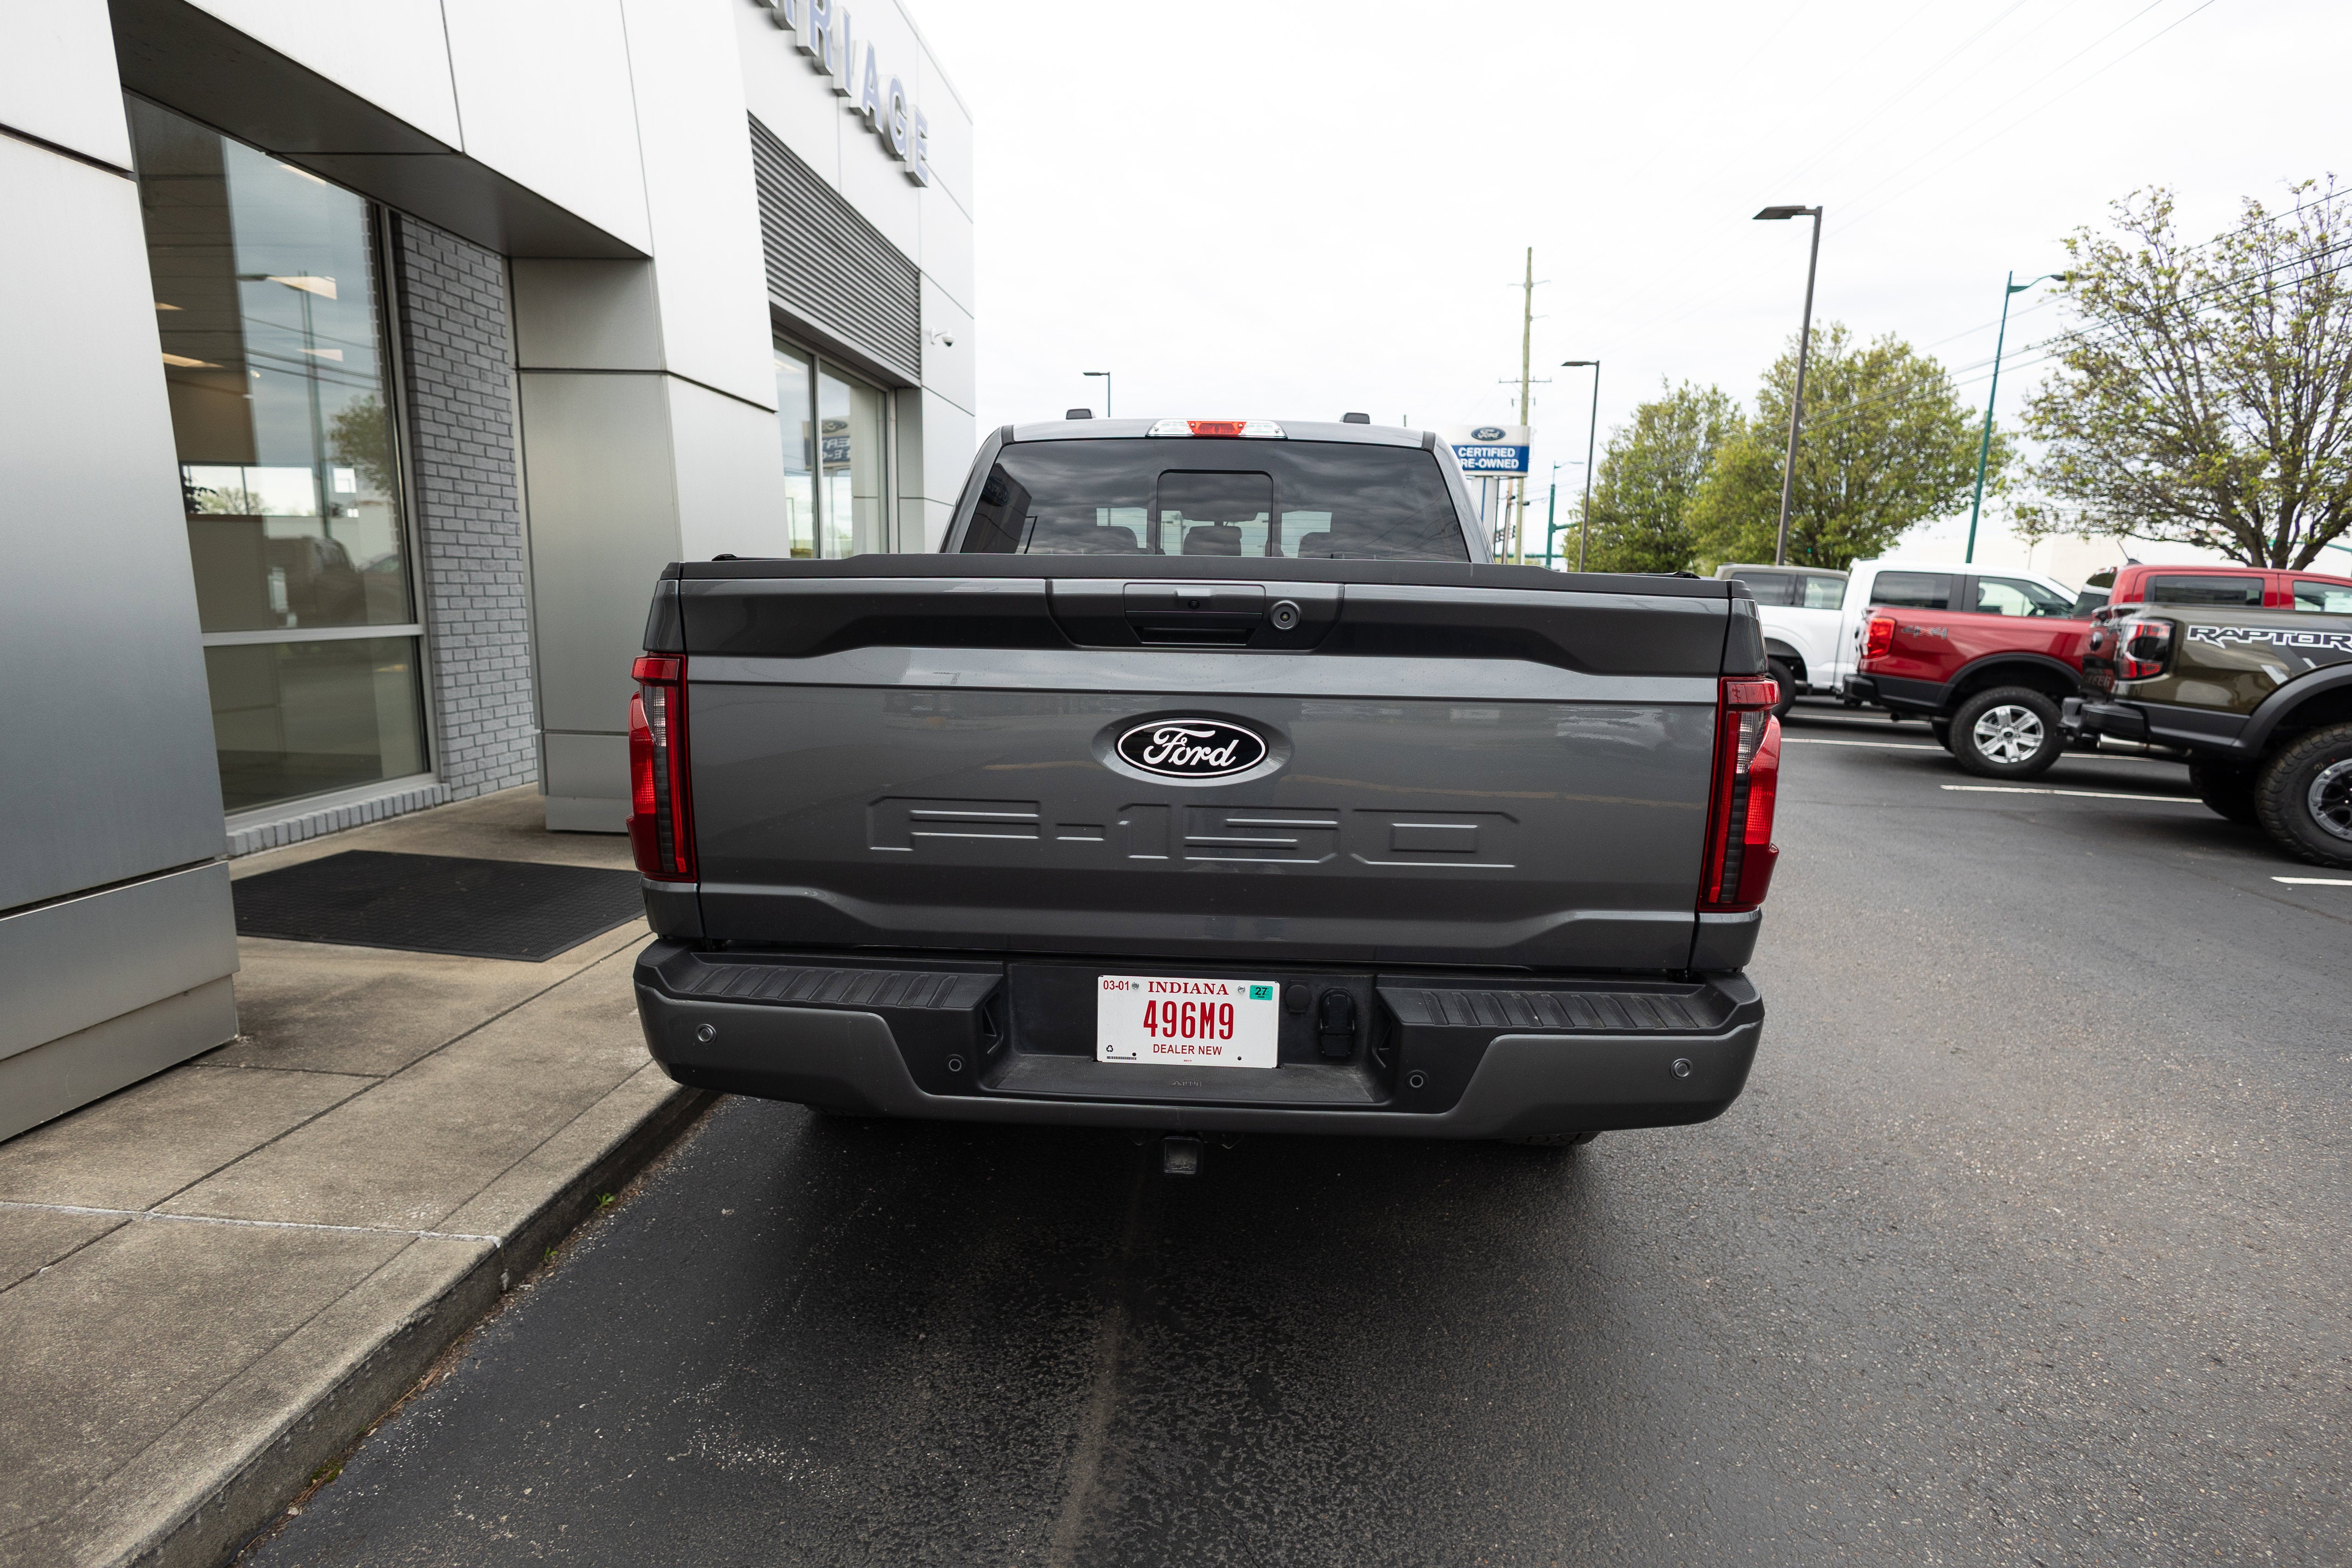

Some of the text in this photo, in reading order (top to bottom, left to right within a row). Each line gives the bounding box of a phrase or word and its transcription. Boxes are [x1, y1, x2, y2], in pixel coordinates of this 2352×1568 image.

[754, 0, 928, 187] RIAGE
[1477, 428, 1500, 438] Ford
[1458, 447, 1515, 458] CERTIFIED
[1459, 458, 1519, 469] RE-OWNED
[2187, 625, 2352, 653] RAPTOR
[1143, 727, 1239, 767] Ford
[868, 795, 1520, 869] F-150
[1103, 980, 1129, 990] 03-01
[1148, 981, 1229, 995] INDIANA
[1255, 987, 1268, 996] 27
[1143, 1000, 1234, 1040] 496M9
[1153, 1044, 1222, 1055] DEALER NEW
